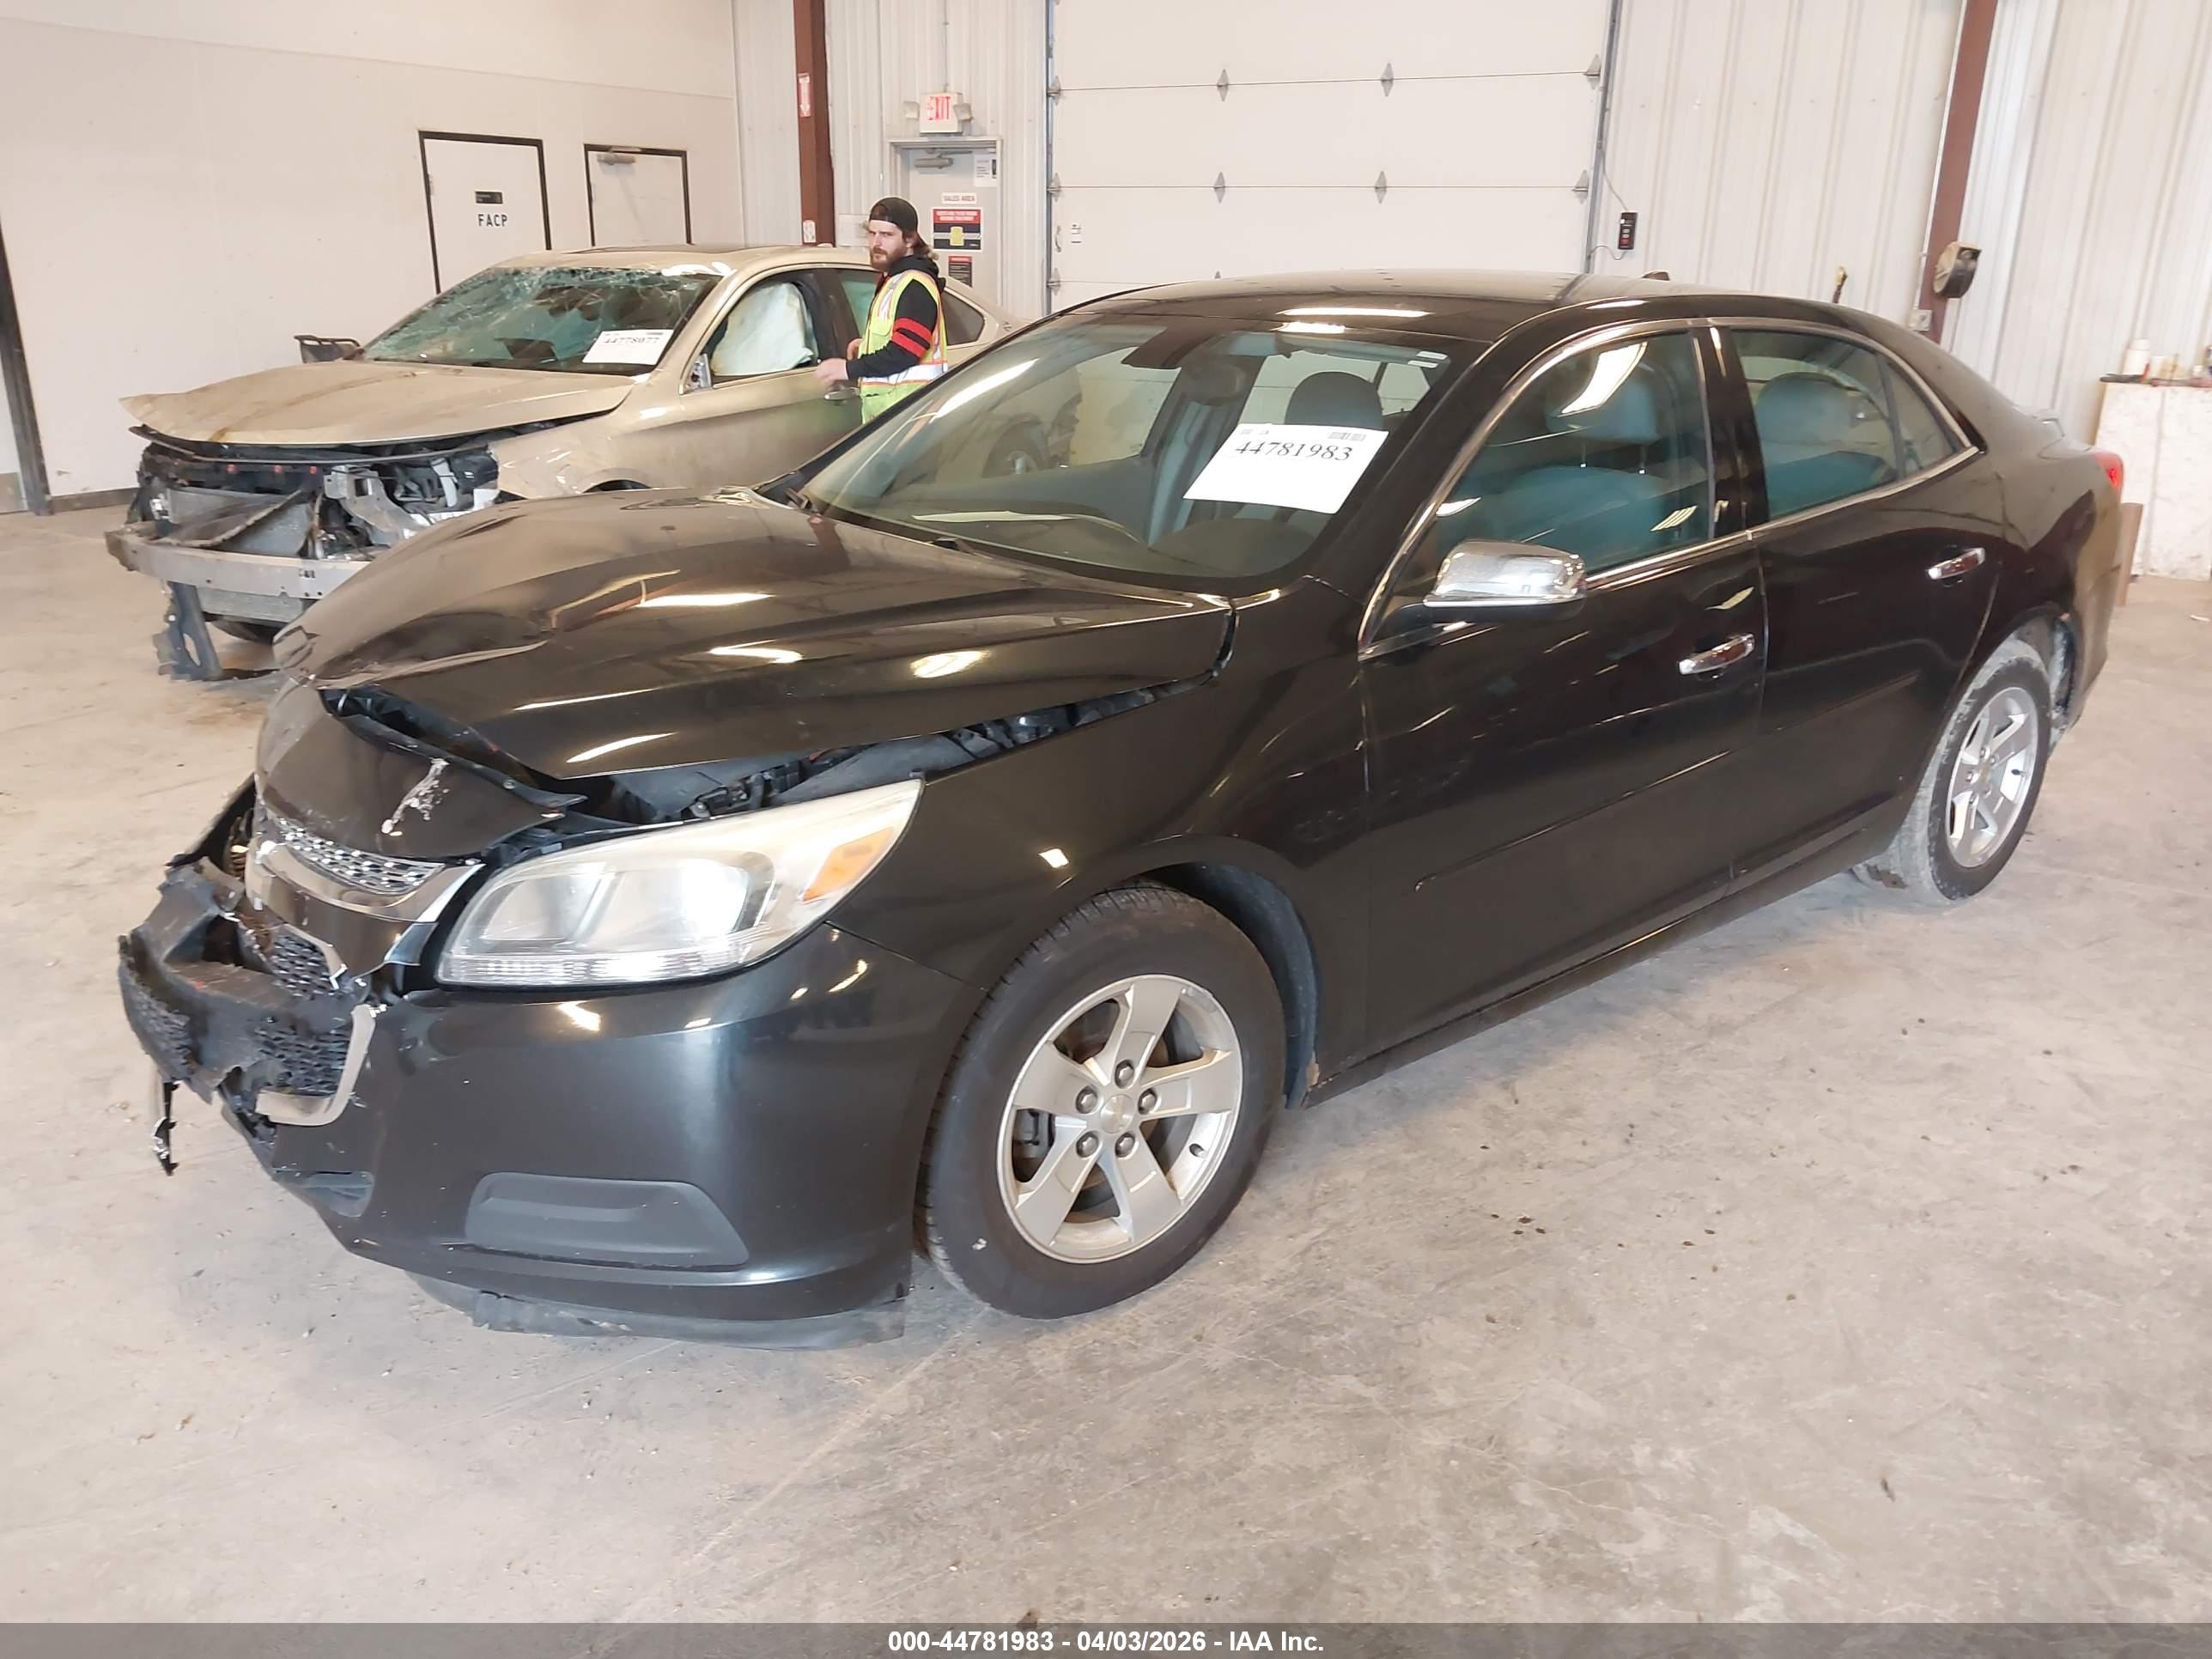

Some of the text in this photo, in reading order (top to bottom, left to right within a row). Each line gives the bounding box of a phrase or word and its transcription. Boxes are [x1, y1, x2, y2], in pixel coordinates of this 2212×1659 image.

[927, 95, 951, 121] EXIT
[477, 213, 508, 228] FACP
[1235, 441, 1353, 461] 44781983
